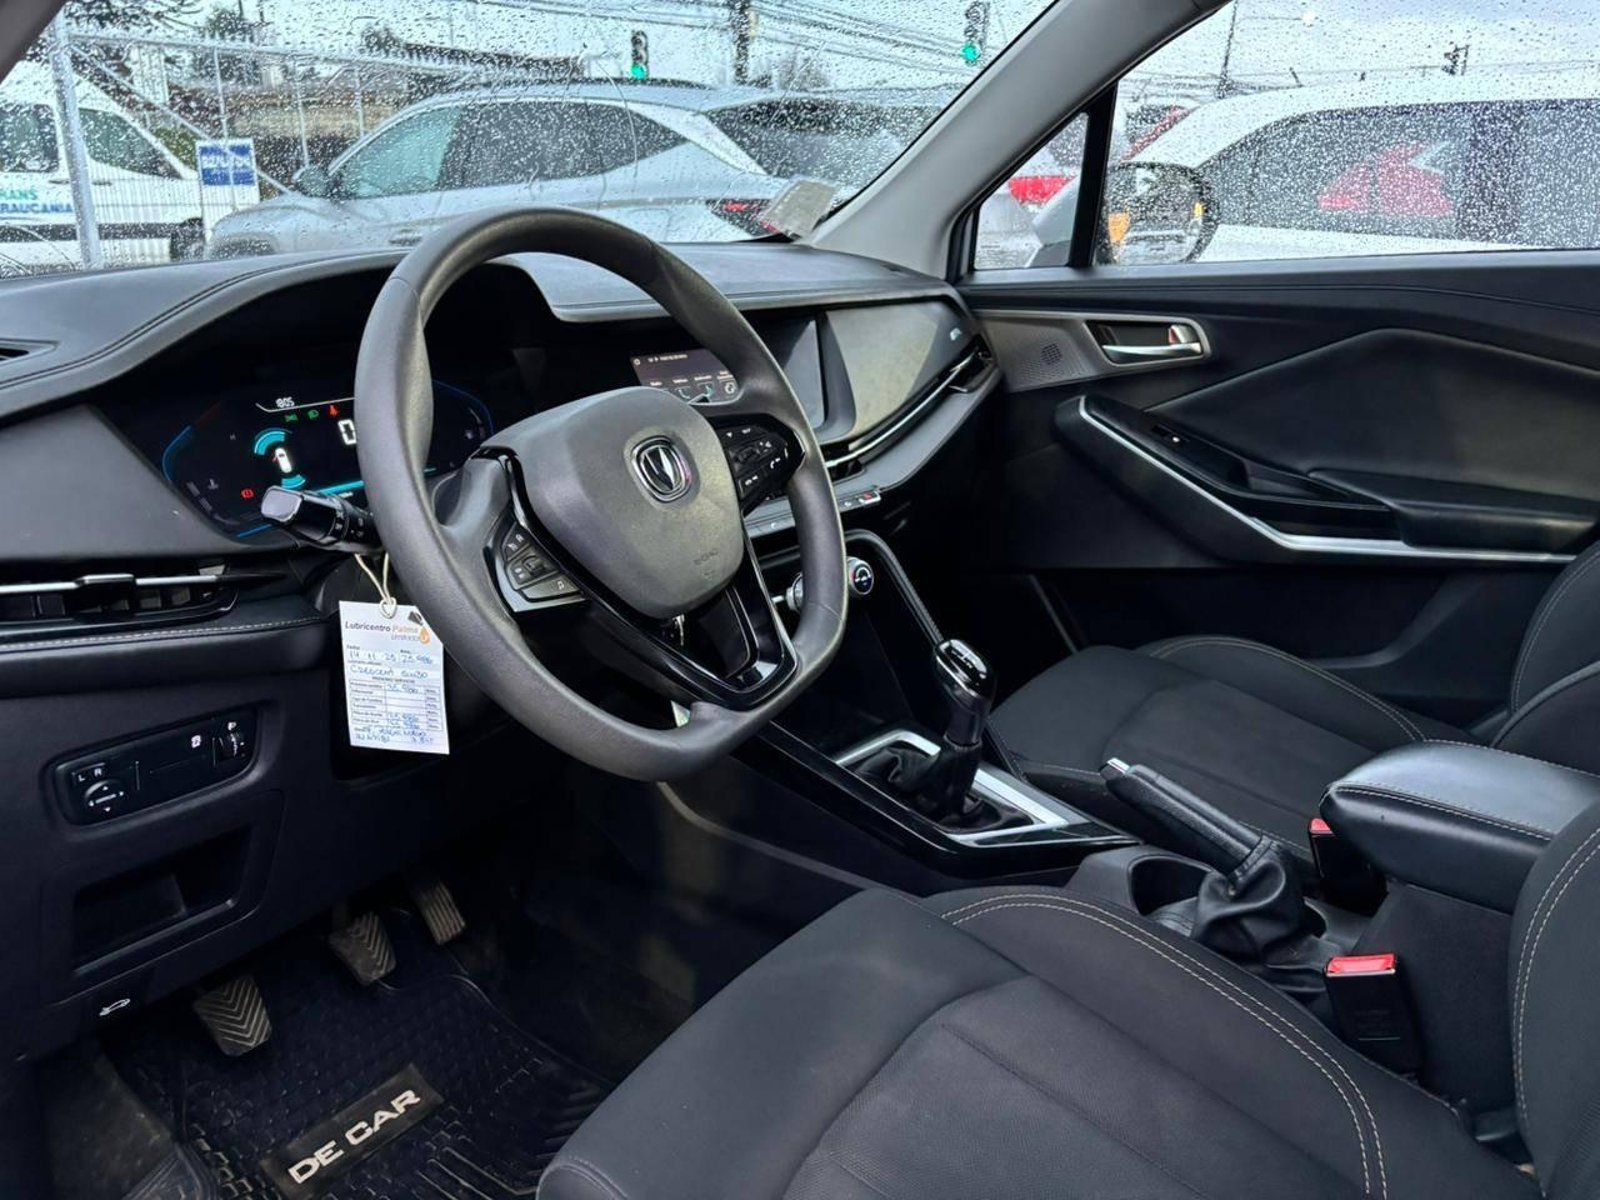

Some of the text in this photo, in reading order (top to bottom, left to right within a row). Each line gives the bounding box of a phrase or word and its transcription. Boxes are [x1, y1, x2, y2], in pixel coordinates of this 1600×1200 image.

[345, 621, 391, 632] Lubricentro
[78, 774, 85, 782] L
[288, 1089, 421, 1184] DE CAR
